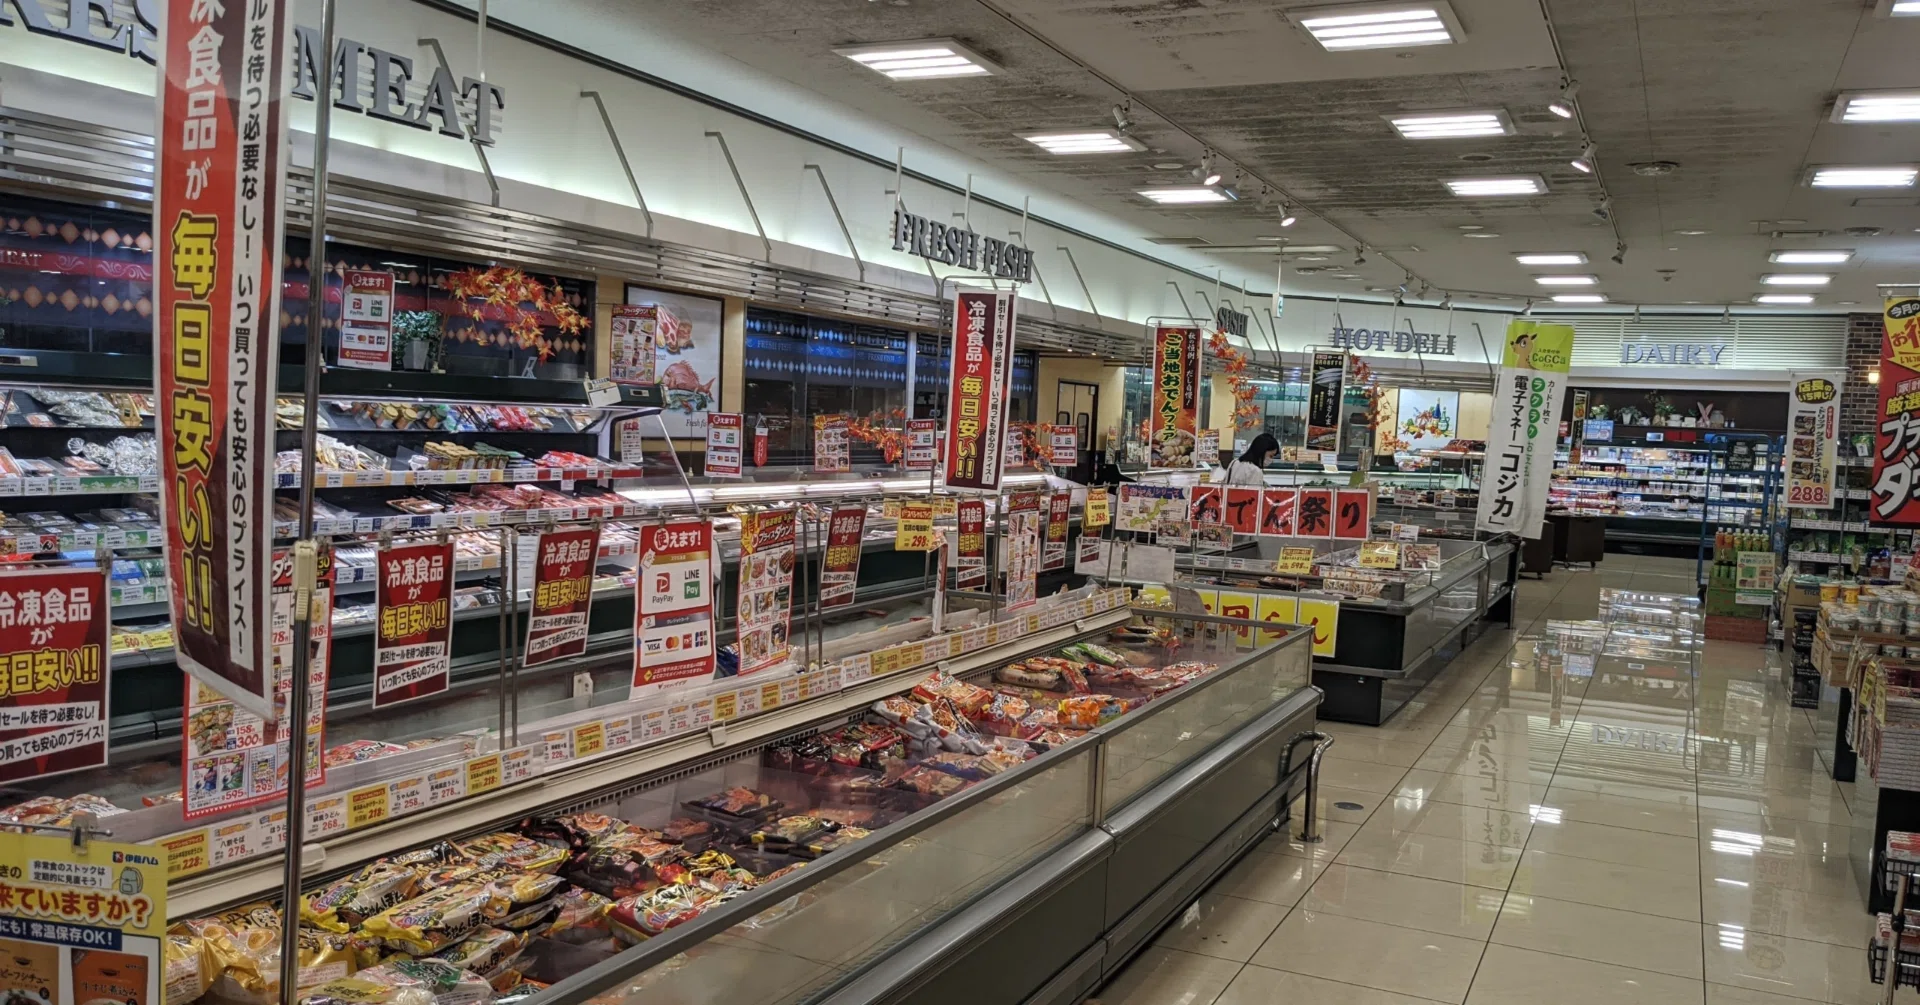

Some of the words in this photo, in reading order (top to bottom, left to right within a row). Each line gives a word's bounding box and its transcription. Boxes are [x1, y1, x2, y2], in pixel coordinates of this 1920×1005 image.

[291, 27, 505, 145] MEAT
[892, 209, 980, 271] FRESH
[982, 236, 1034, 283] FISH
[1217, 305, 1249, 338] SUSHI
[1332, 327, 1390, 352] HOT
[1394, 331, 1457, 356] DELI
[1619, 343, 1726, 365] DAIRY
[1160, 333, 1182, 441] ご当地おでんフェア
[1873, 451, 1920, 517] ダ
[1790, 486, 1824, 501] 288
[911, 535, 927, 547] 298
[542, 539, 591, 566] 冷凍食品
[387, 555, 444, 588] 冷凍食品
[560, 564, 572, 576] が
[684, 569, 700, 580] LINE
[408, 584, 423, 600] が
[686, 585, 699, 596] Pay
[652, 594, 674, 604] PayPay
[30, 625, 55, 645] が
[647, 640, 661, 651] VISA
[0, 706, 95, 727] セールを待つ必要なし!
[236, 734, 259, 748] 300
[441, 787, 455, 798] 278
[404, 798, 418, 809] 258
[367, 809, 383, 820] 218
[322, 819, 338, 831] 268
[227, 844, 246, 858] 278
[33, 860, 106, 876] 非常食のストックは
[182, 856, 200, 871] 228
[33, 871, 103, 887] 定期的に見直そう!
[31, 924, 113, 946] 常温保存OK!
